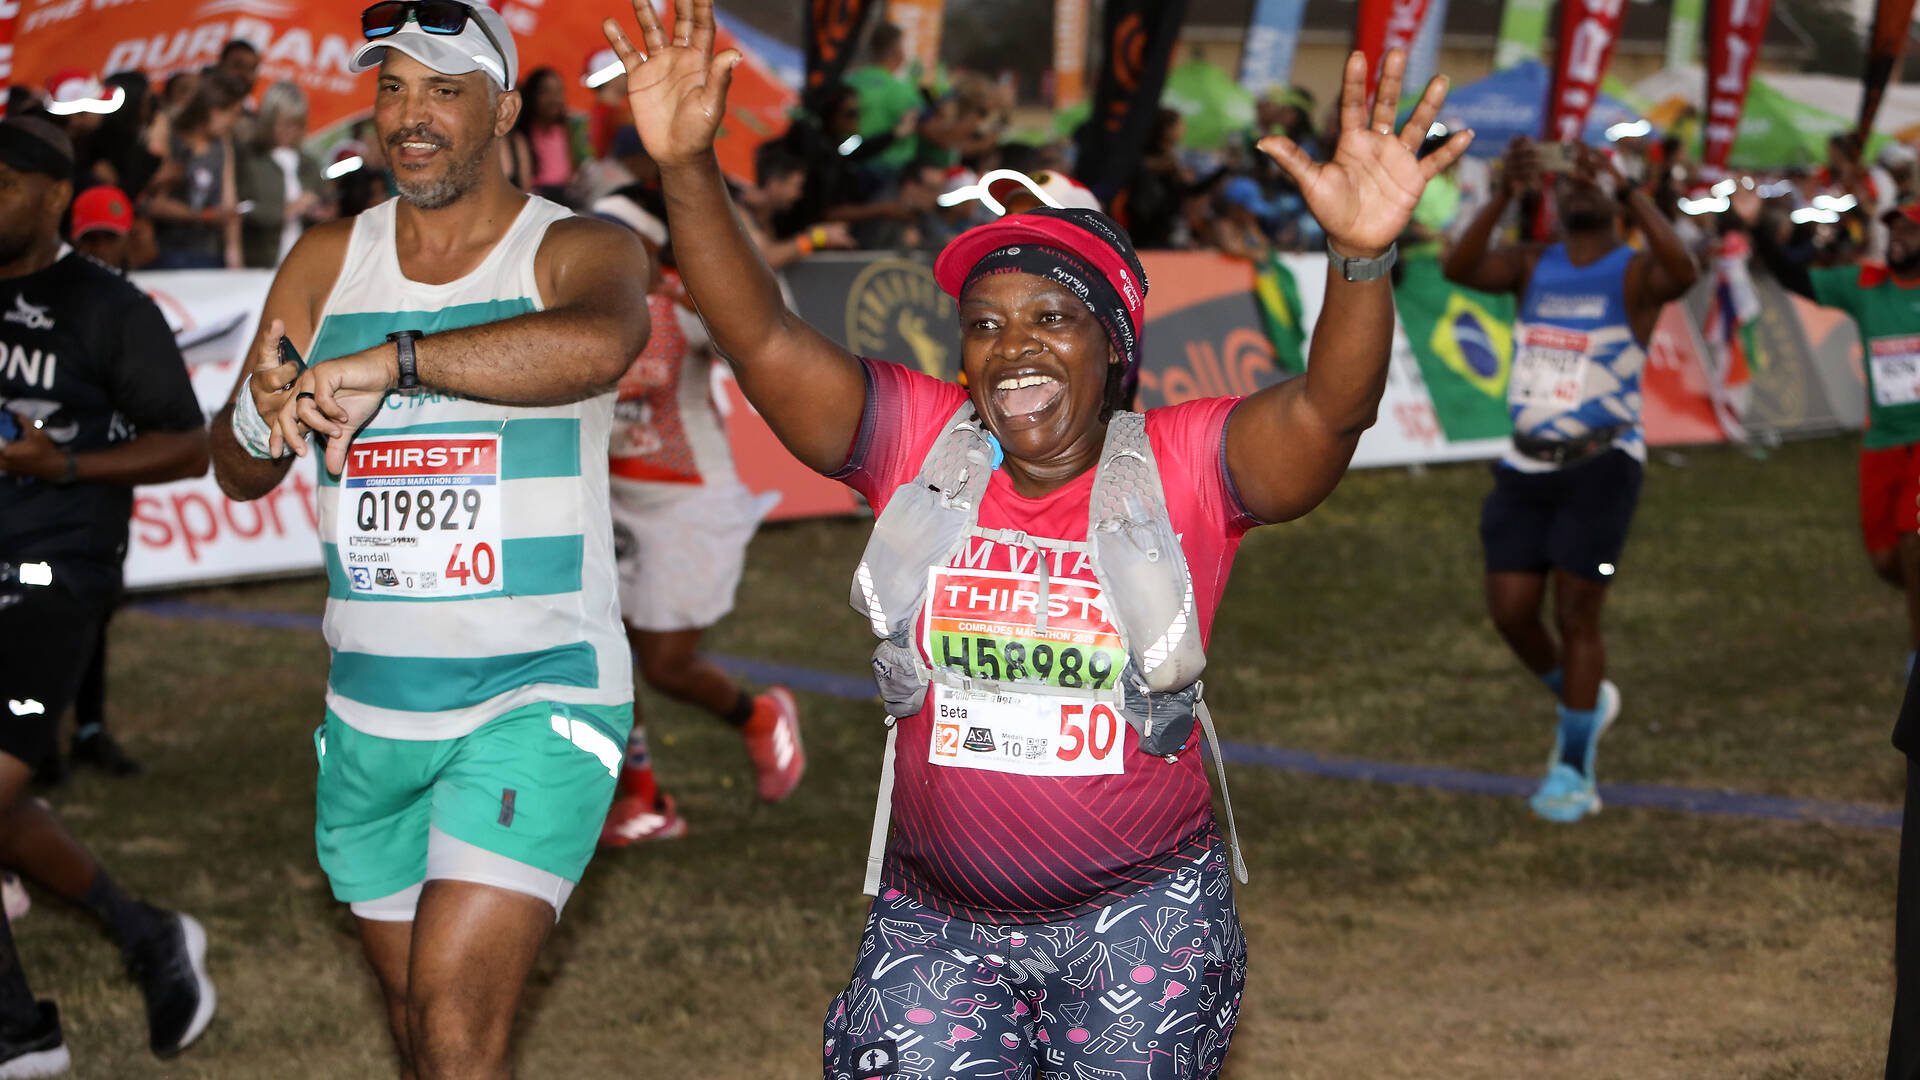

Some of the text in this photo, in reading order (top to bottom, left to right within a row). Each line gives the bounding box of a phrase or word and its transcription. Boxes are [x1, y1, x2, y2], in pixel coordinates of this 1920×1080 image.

[102, 17, 359, 76] DURBAN
[1053, 266, 1089, 298] Vitality
[353, 446, 482, 469] THIRSTI
[365, 478, 406, 487] COMRADES
[407, 477, 452, 486] MARATHON
[131, 472, 319, 564] sport
[357, 489, 481, 532] Q19829
[349, 552, 390, 563] Randall
[445, 541, 496, 587] 40
[353, 568, 370, 589] 3
[376, 568, 396, 580] ASA
[406, 576, 414, 589] 0
[958, 622, 1015, 636] COMRADES
[942, 635, 1112, 690] H58989
[940, 704, 968, 719] Beta
[942, 727, 958, 754] 2
[967, 730, 992, 743] ASA
[1055, 703, 1117, 762] 50
[1002, 740, 1021, 757] 10
